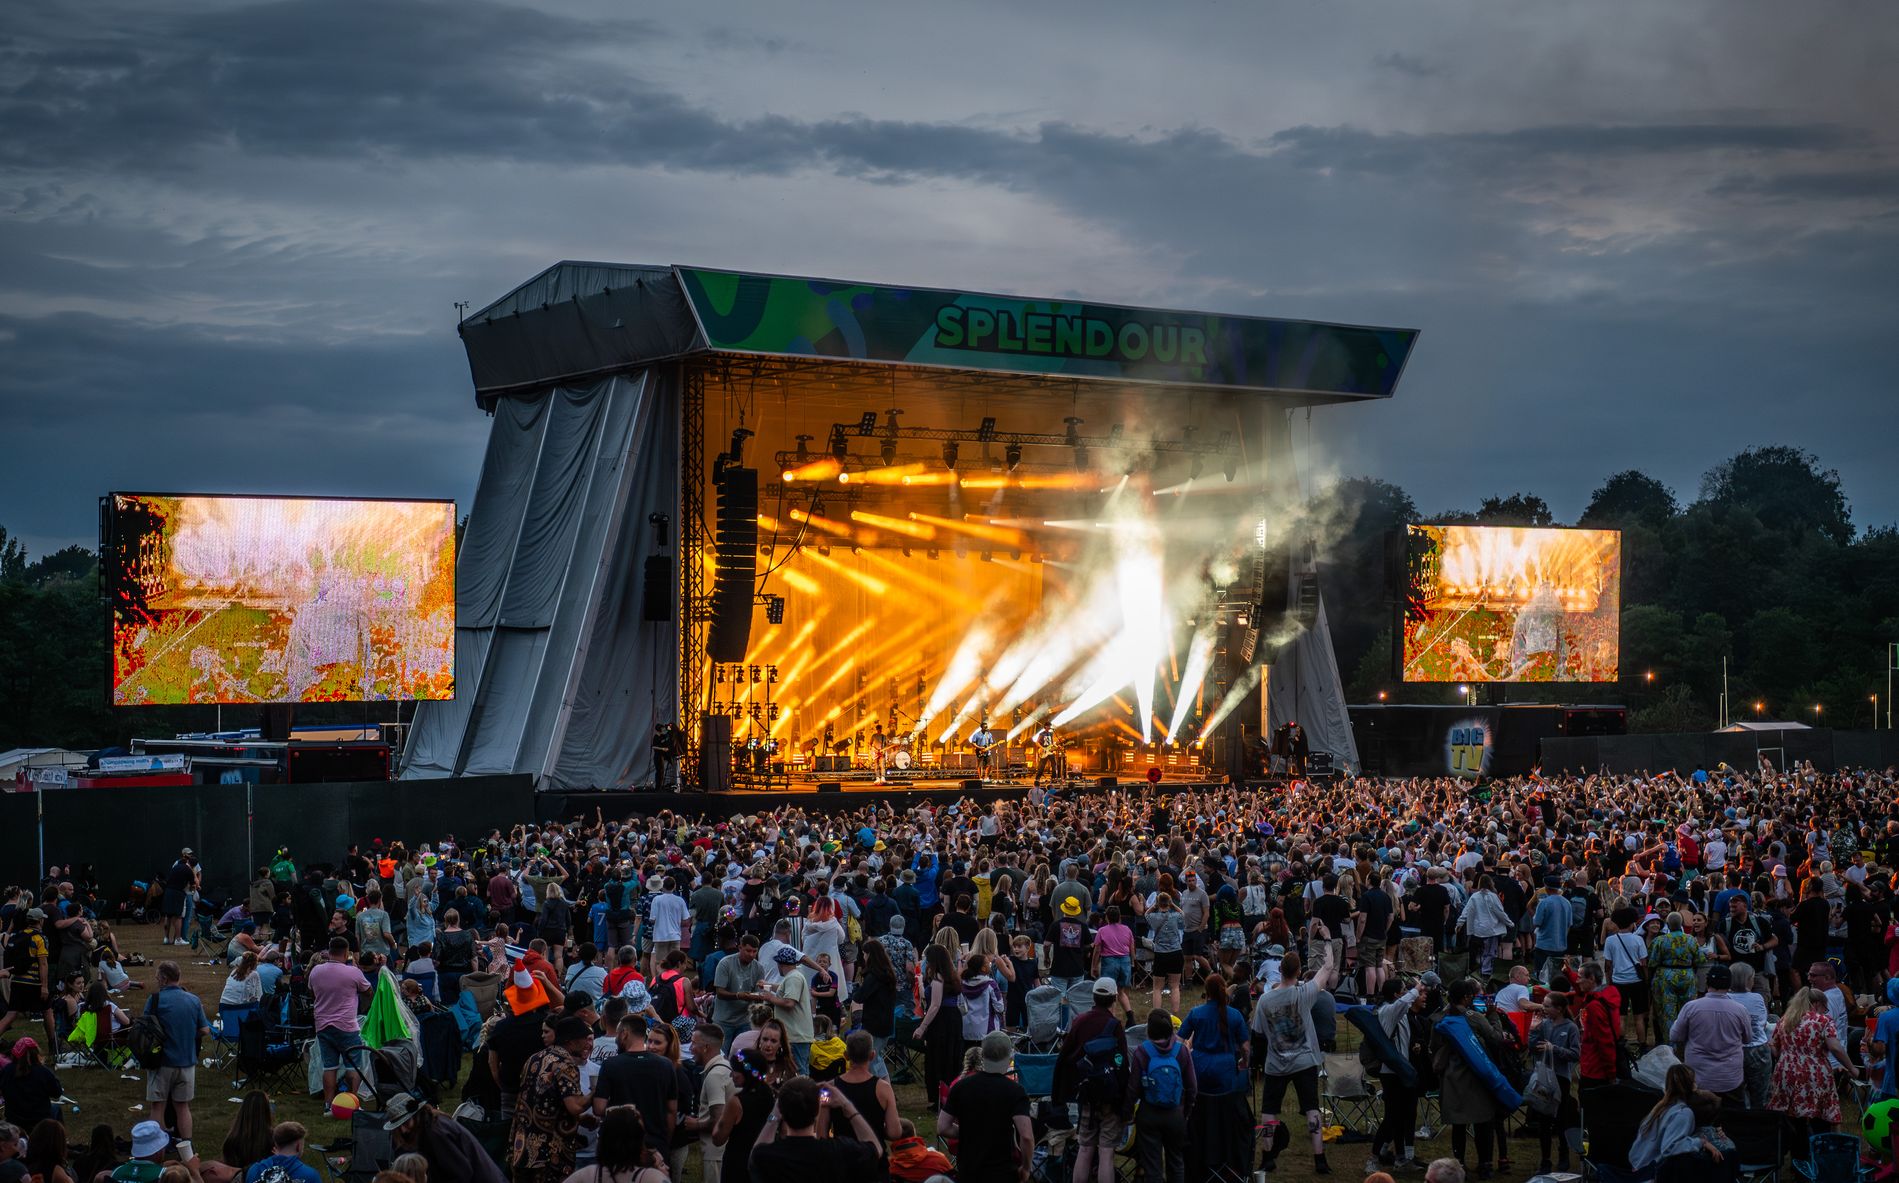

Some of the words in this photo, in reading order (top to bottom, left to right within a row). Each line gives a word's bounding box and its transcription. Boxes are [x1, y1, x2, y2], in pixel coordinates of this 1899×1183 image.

[935, 305, 1208, 364] SPLENDOUR
[1451, 728, 1483, 745] BIG
[1451, 745, 1482, 771] TV
[597, 912, 606, 926] 7
